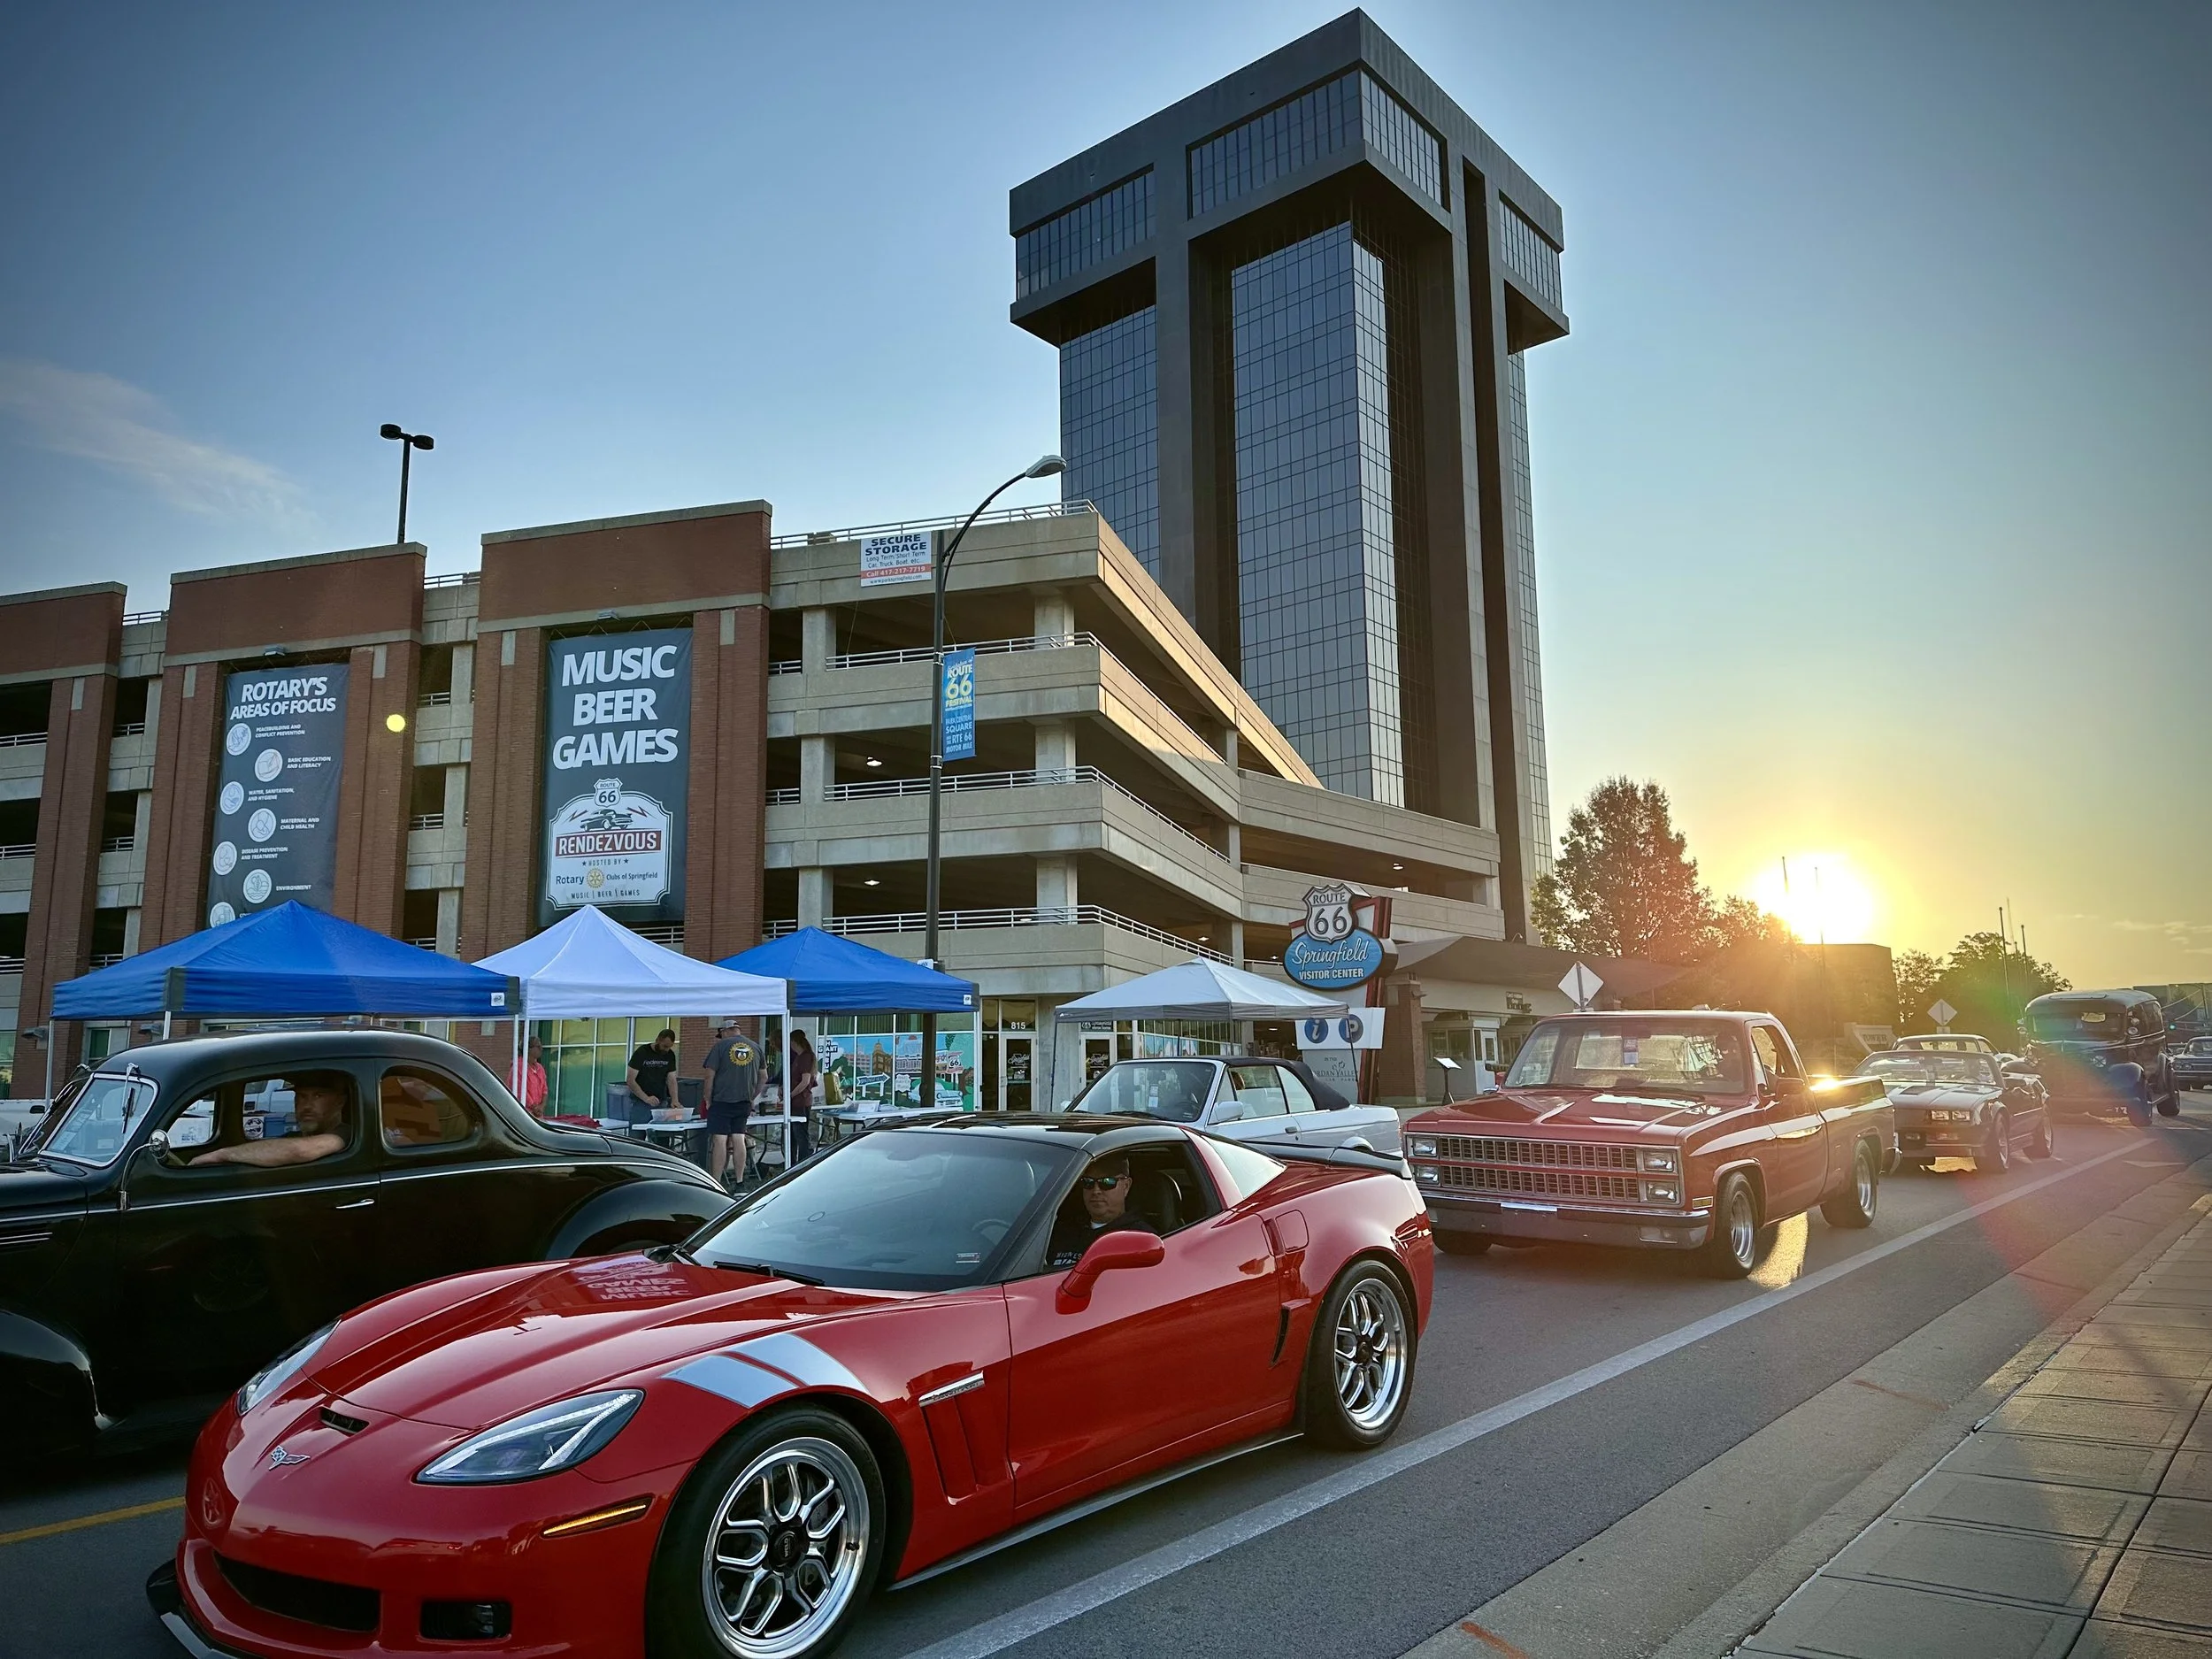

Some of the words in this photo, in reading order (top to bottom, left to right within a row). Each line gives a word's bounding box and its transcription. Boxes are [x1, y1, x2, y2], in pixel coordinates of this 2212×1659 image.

[871, 534, 921, 547] SECURE
[864, 542, 927, 556] STORAGE
[562, 645, 678, 687] MUSIC
[947, 664, 972, 679] ROUTE
[242, 676, 328, 703] ROTARY'S
[946, 673, 972, 700] 66
[572, 687, 658, 726] BEER
[945, 695, 972, 708] FESTIVAL
[230, 703, 271, 720] AREAS
[271, 701, 290, 716] OF
[289, 697, 336, 714] FOCUS
[945, 721, 972, 734] SQUARE
[952, 733, 963, 744] RTE
[964, 731, 972, 742] 66
[553, 728, 679, 770] GAMES
[946, 744, 962, 753] MOTOR
[598, 790, 617, 803] 66
[558, 832, 657, 856] RENDEZVOUS
[556, 875, 585, 885] Rotary
[628, 872, 658, 881] Springfield
[1312, 891, 1346, 904] ROUTE
[1313, 906, 1348, 935] 66
[1292, 937, 1370, 970] Springfield
[1299, 970, 1330, 980] VISITOR
[1332, 968, 1364, 979] CENTER
[1010, 1021, 1026, 1030] 815
